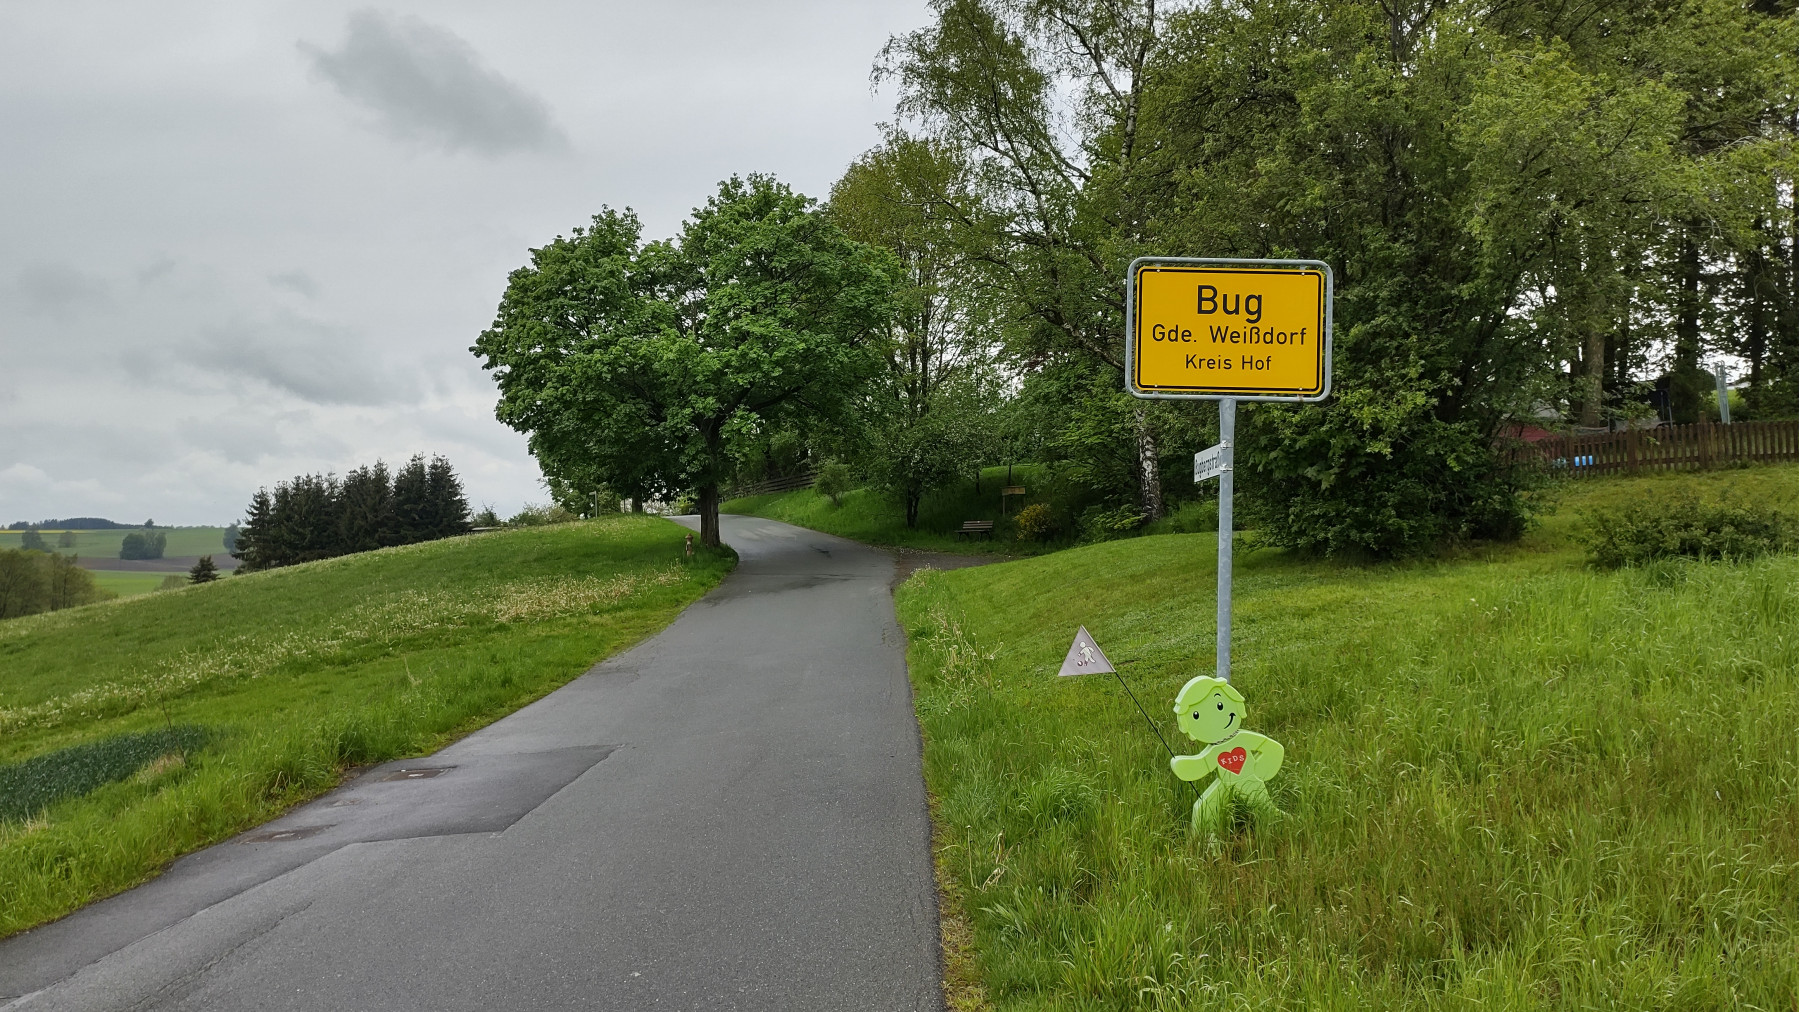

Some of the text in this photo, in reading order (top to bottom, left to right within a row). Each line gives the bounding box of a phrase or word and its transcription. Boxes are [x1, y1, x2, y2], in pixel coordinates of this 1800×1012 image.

[1197, 285, 1263, 324] Bug
[1152, 323, 1307, 345] Gde. Weißdorf
[1185, 354, 1272, 371] Kreis Hof
[1221, 755, 1244, 764] KIDS
